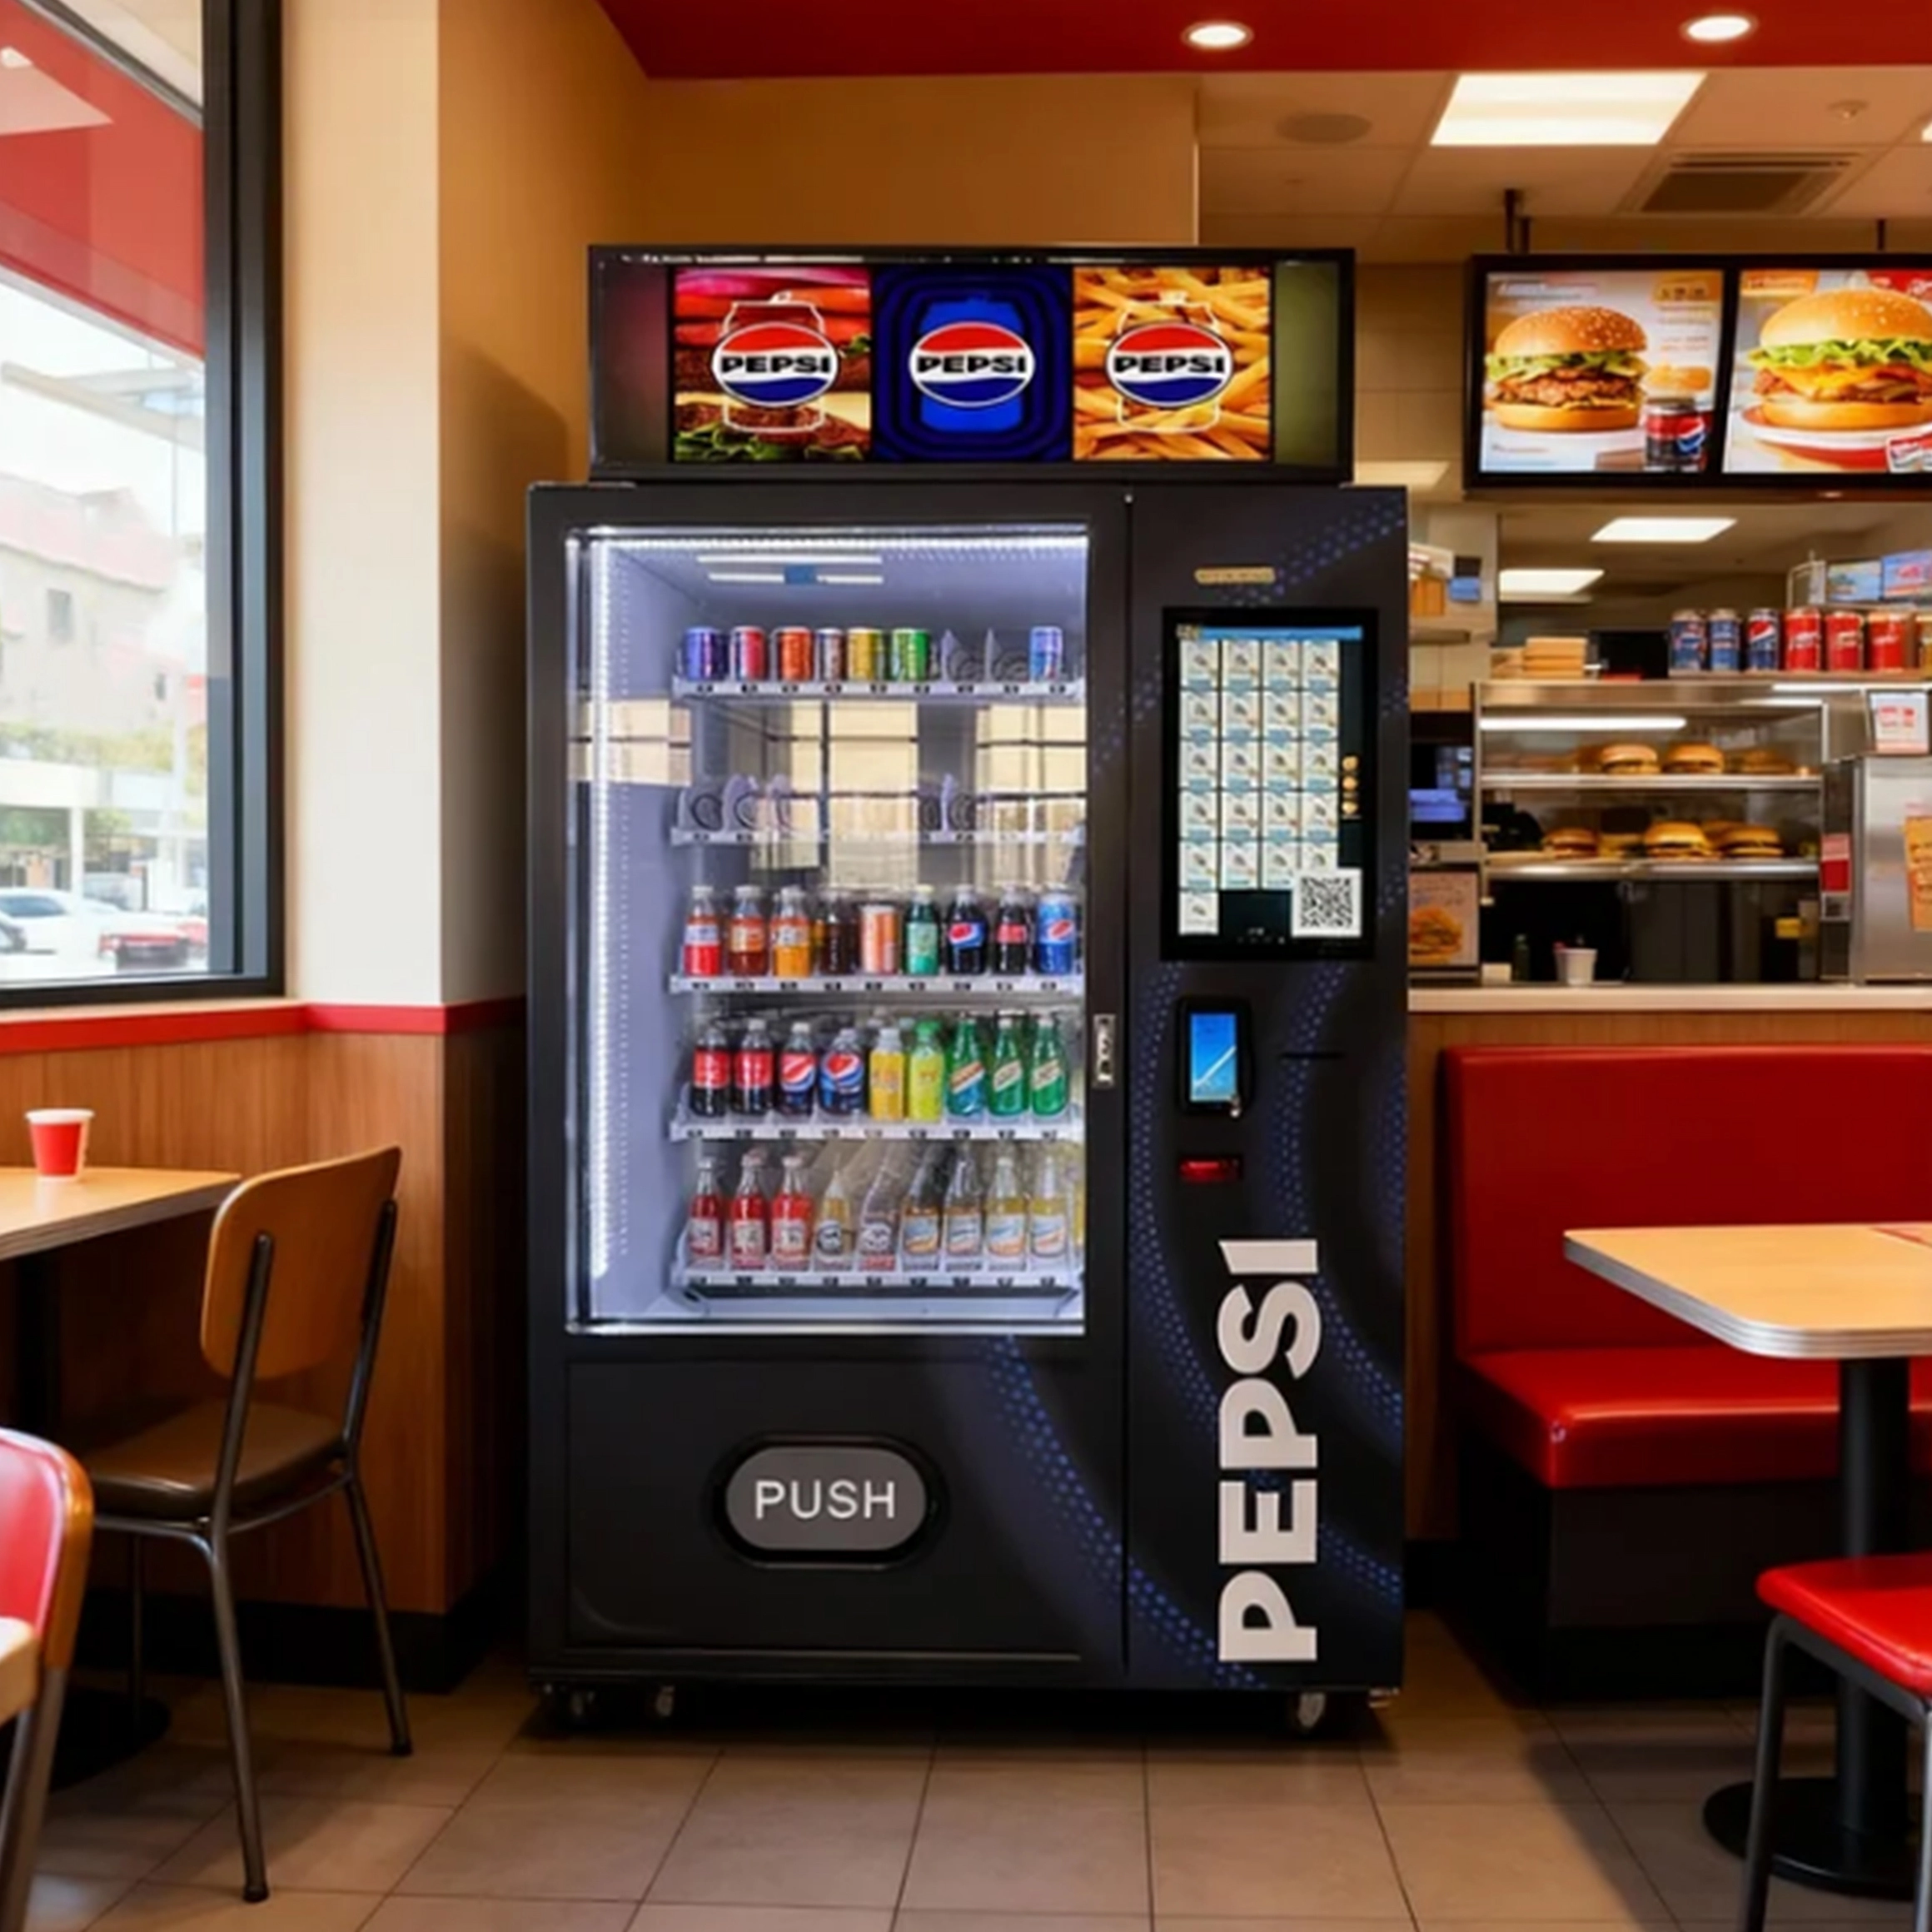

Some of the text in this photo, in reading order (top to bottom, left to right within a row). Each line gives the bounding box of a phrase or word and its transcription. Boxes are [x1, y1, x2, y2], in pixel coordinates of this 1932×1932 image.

[720, 355, 832, 374] PEPSI
[916, 355, 1027, 374] PEPSI
[1113, 354, 1225, 373] PEPSI
[1217, 1238, 1322, 1661] PEPSI
[755, 1479, 895, 1520] PUSH
